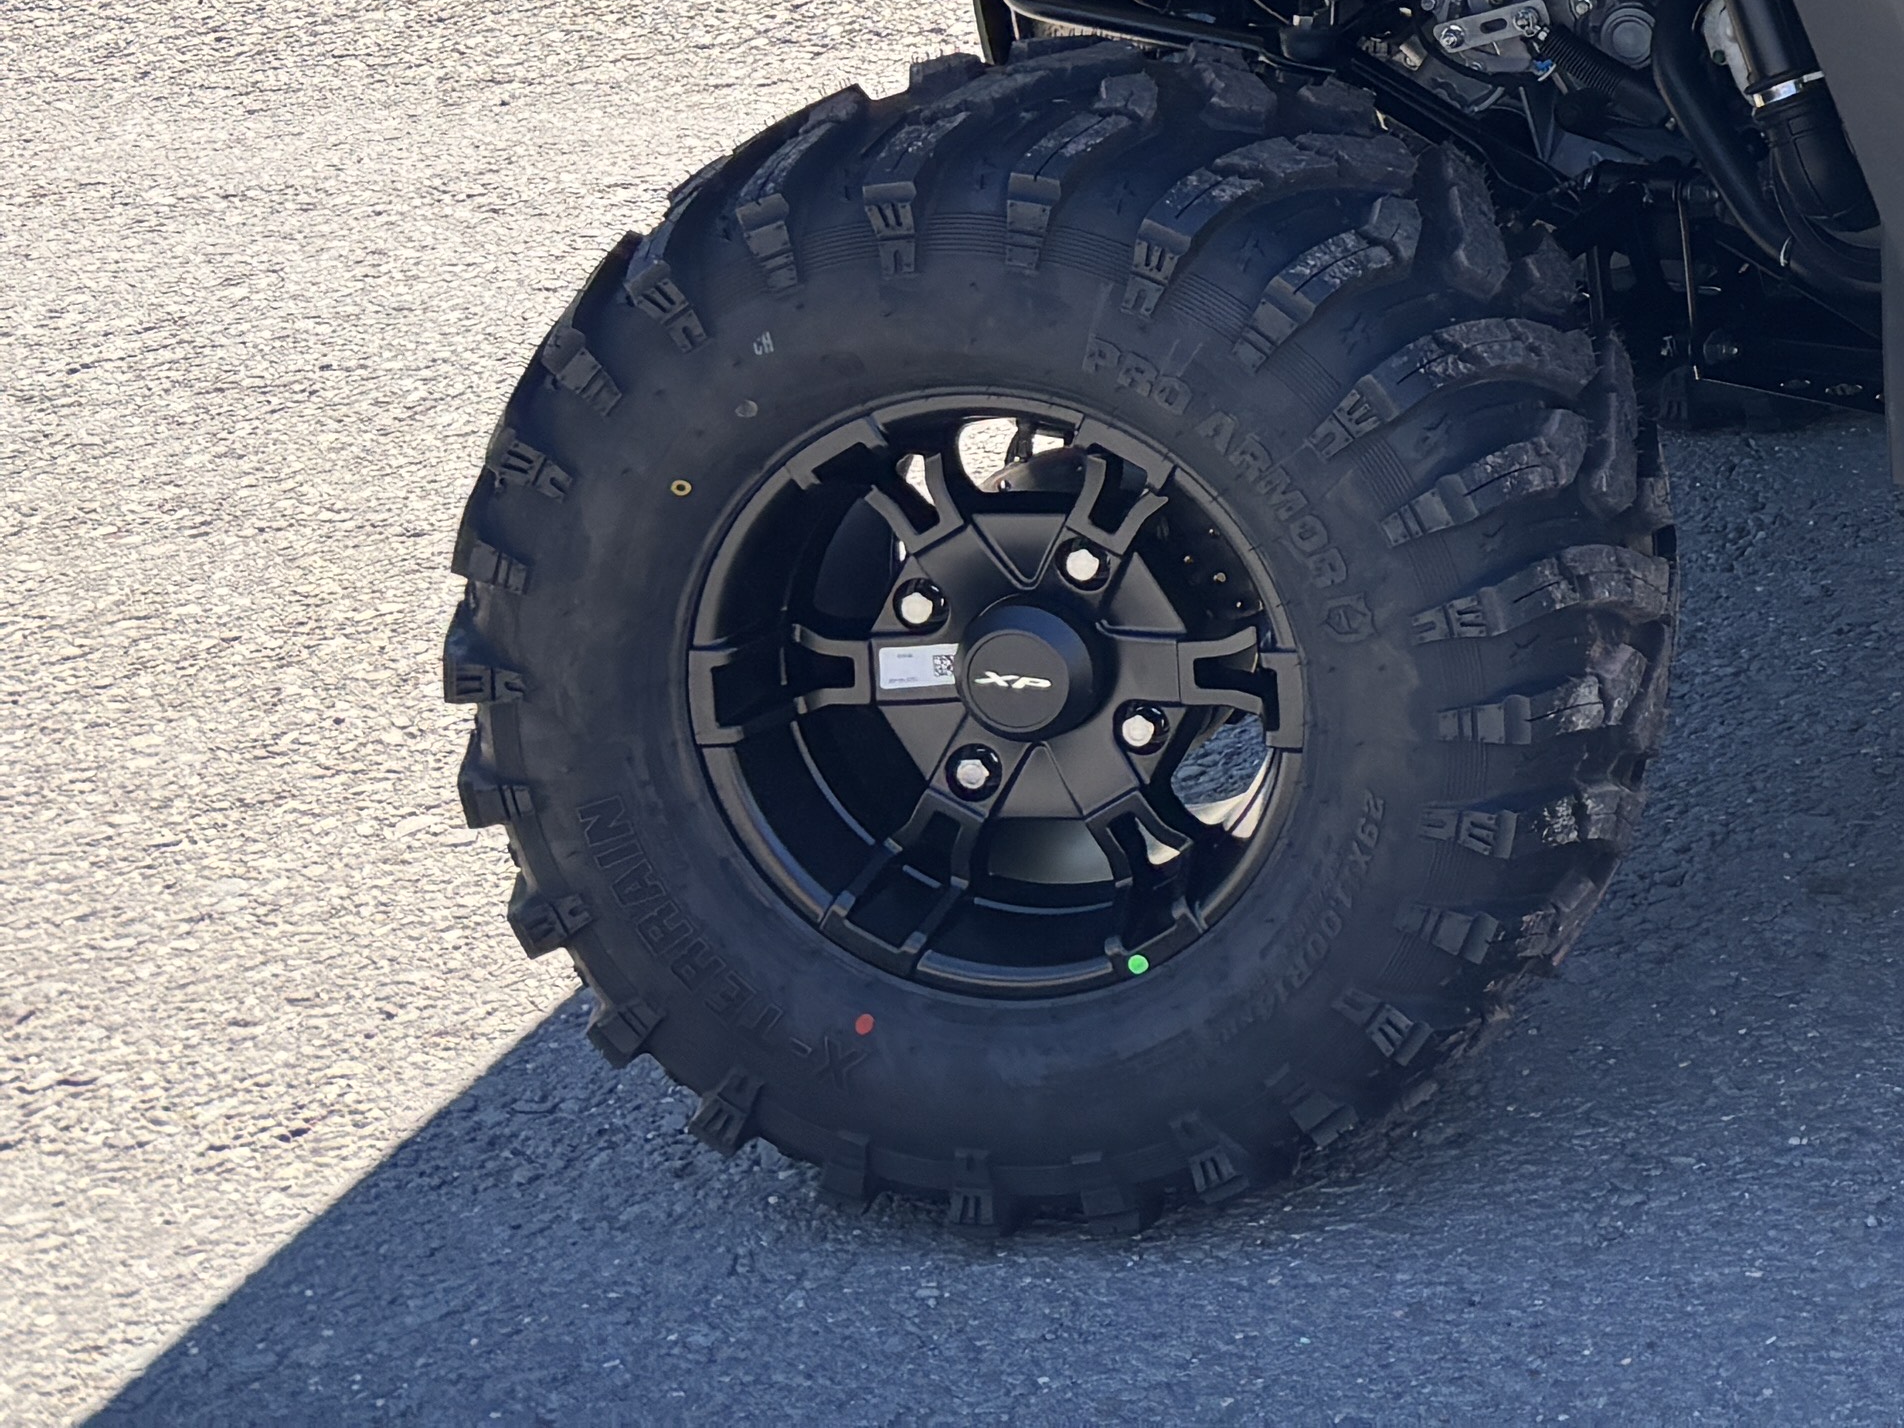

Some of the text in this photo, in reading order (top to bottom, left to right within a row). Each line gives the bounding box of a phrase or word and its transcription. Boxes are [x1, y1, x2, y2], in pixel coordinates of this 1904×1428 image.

[1082, 336, 1348, 589] PRO ARMOR
[973, 670, 1052, 689] XP
[576, 794, 868, 1086] X-TERRAIN
